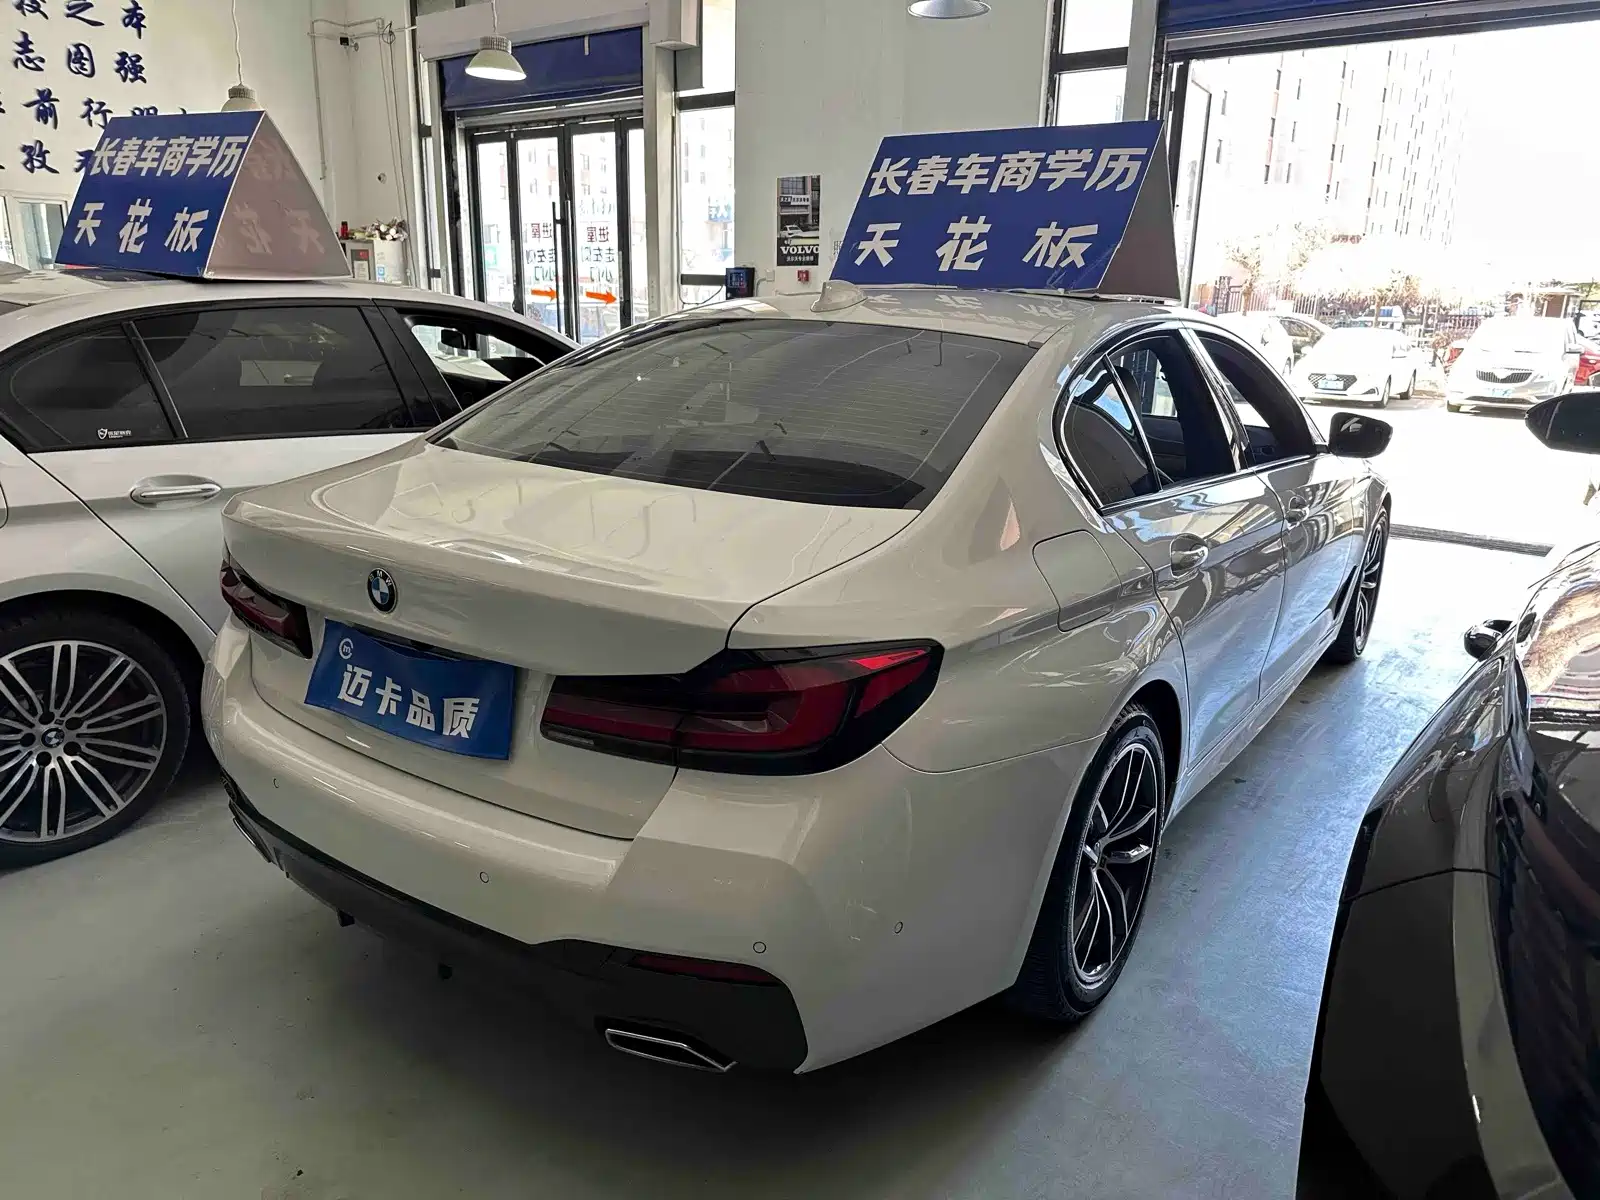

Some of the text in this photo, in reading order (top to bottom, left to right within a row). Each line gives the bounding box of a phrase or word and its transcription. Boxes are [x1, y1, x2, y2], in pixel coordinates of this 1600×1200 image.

[91, 136, 248, 177] 长春车商学历
[869, 148, 1147, 197] 长春车商学历
[75, 198, 209, 254] 天花板
[780, 245, 819, 254] VOLVO
[854, 215, 1099, 272] 天花板
[338, 665, 479, 738] 迈卡品质
